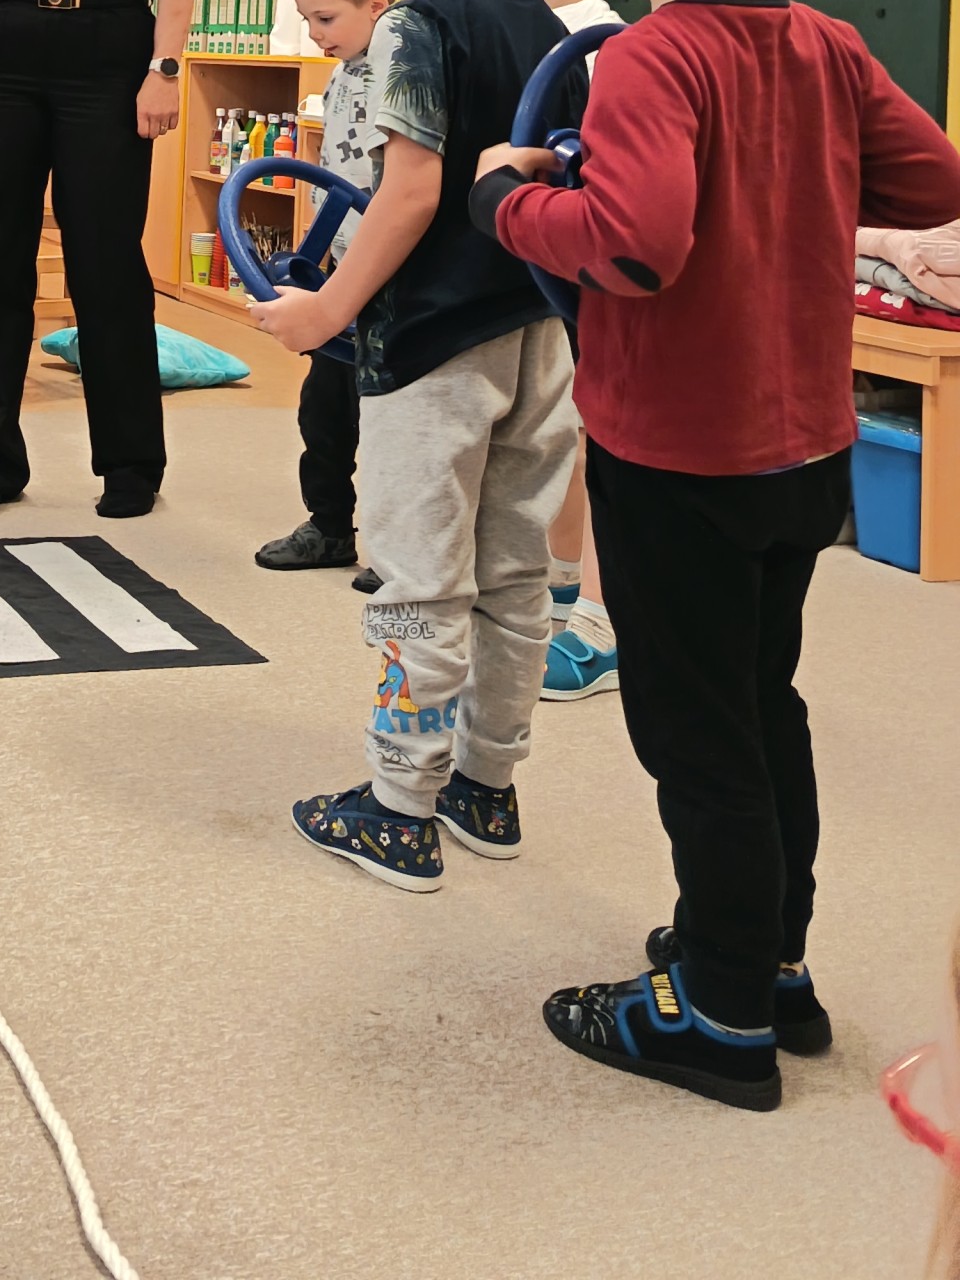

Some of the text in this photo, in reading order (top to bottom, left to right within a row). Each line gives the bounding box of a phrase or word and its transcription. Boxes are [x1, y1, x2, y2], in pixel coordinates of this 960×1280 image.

[366, 602, 420, 621] PAW
[366, 622, 436, 640] PATROL
[651, 974, 679, 1013] BATMAN
